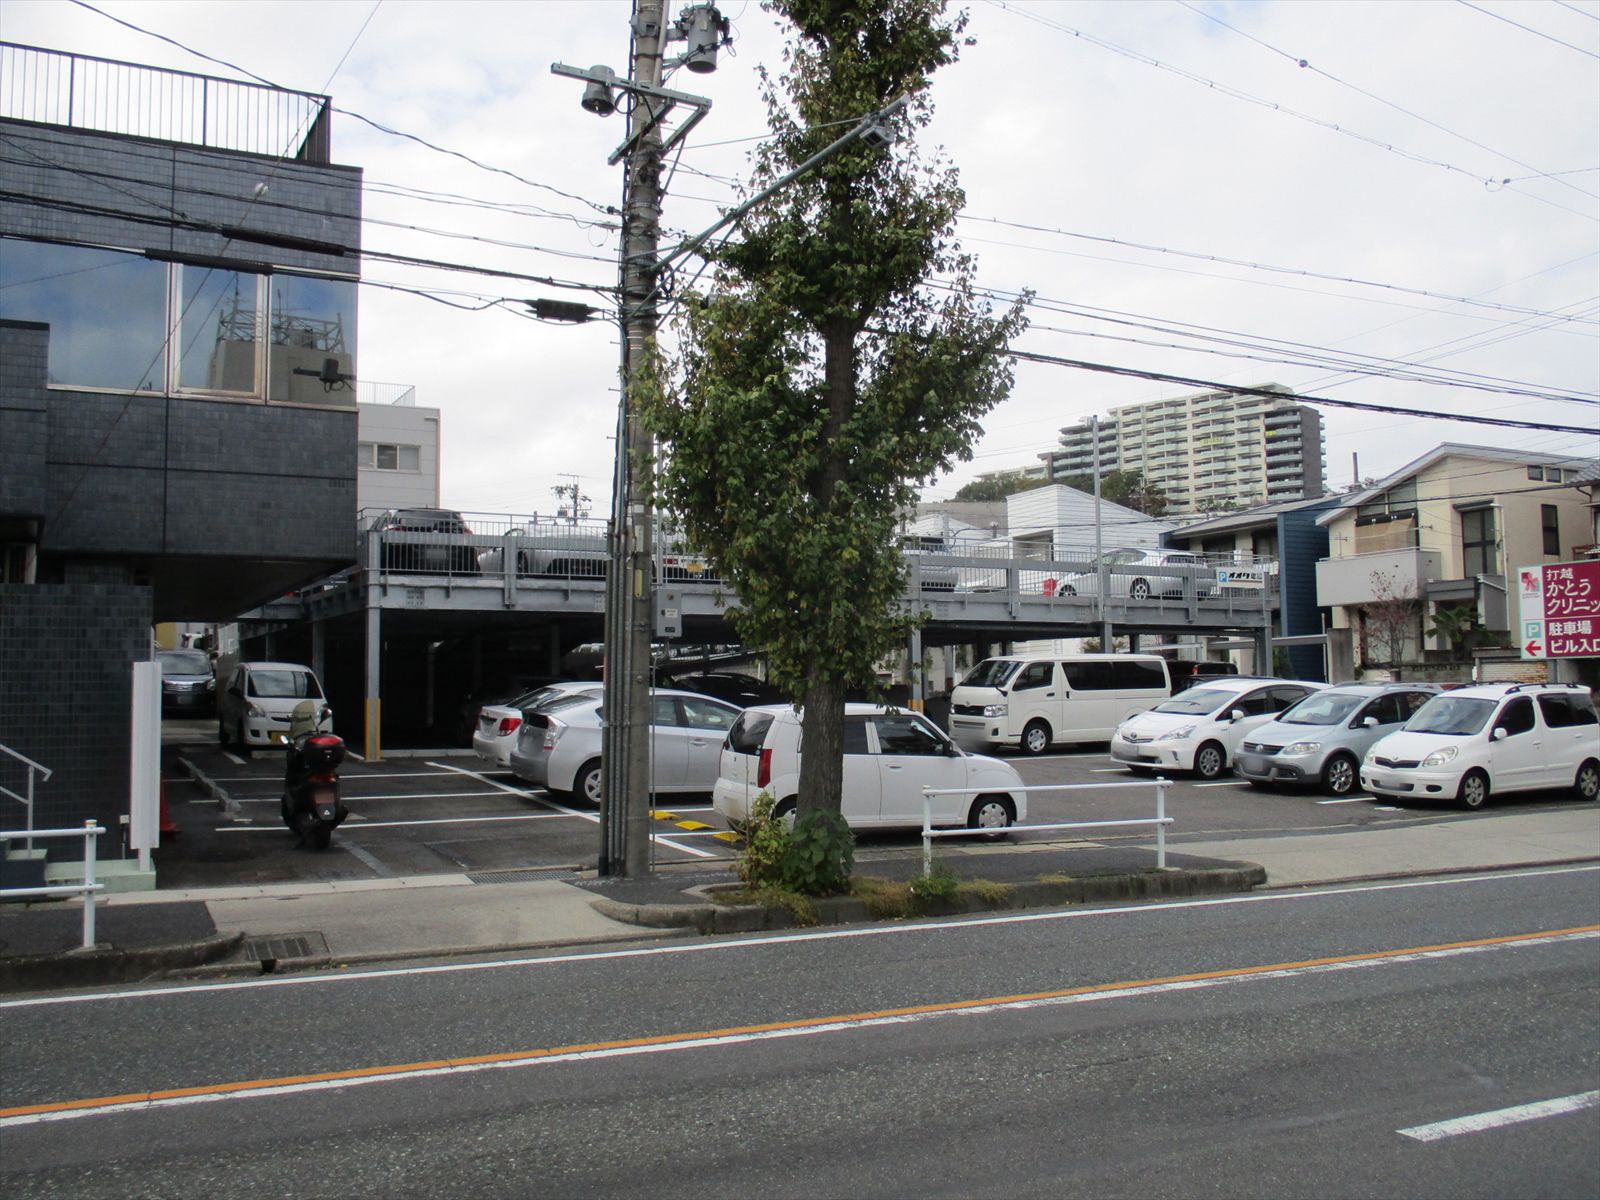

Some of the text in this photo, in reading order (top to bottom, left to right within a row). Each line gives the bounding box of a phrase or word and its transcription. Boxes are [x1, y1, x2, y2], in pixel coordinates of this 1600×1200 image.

[1546, 568, 1573, 581] 打越
[1546, 578, 1591, 597] かとう
[1528, 625, 1539, 637] P
[1549, 620, 1592, 636] 駐車場
